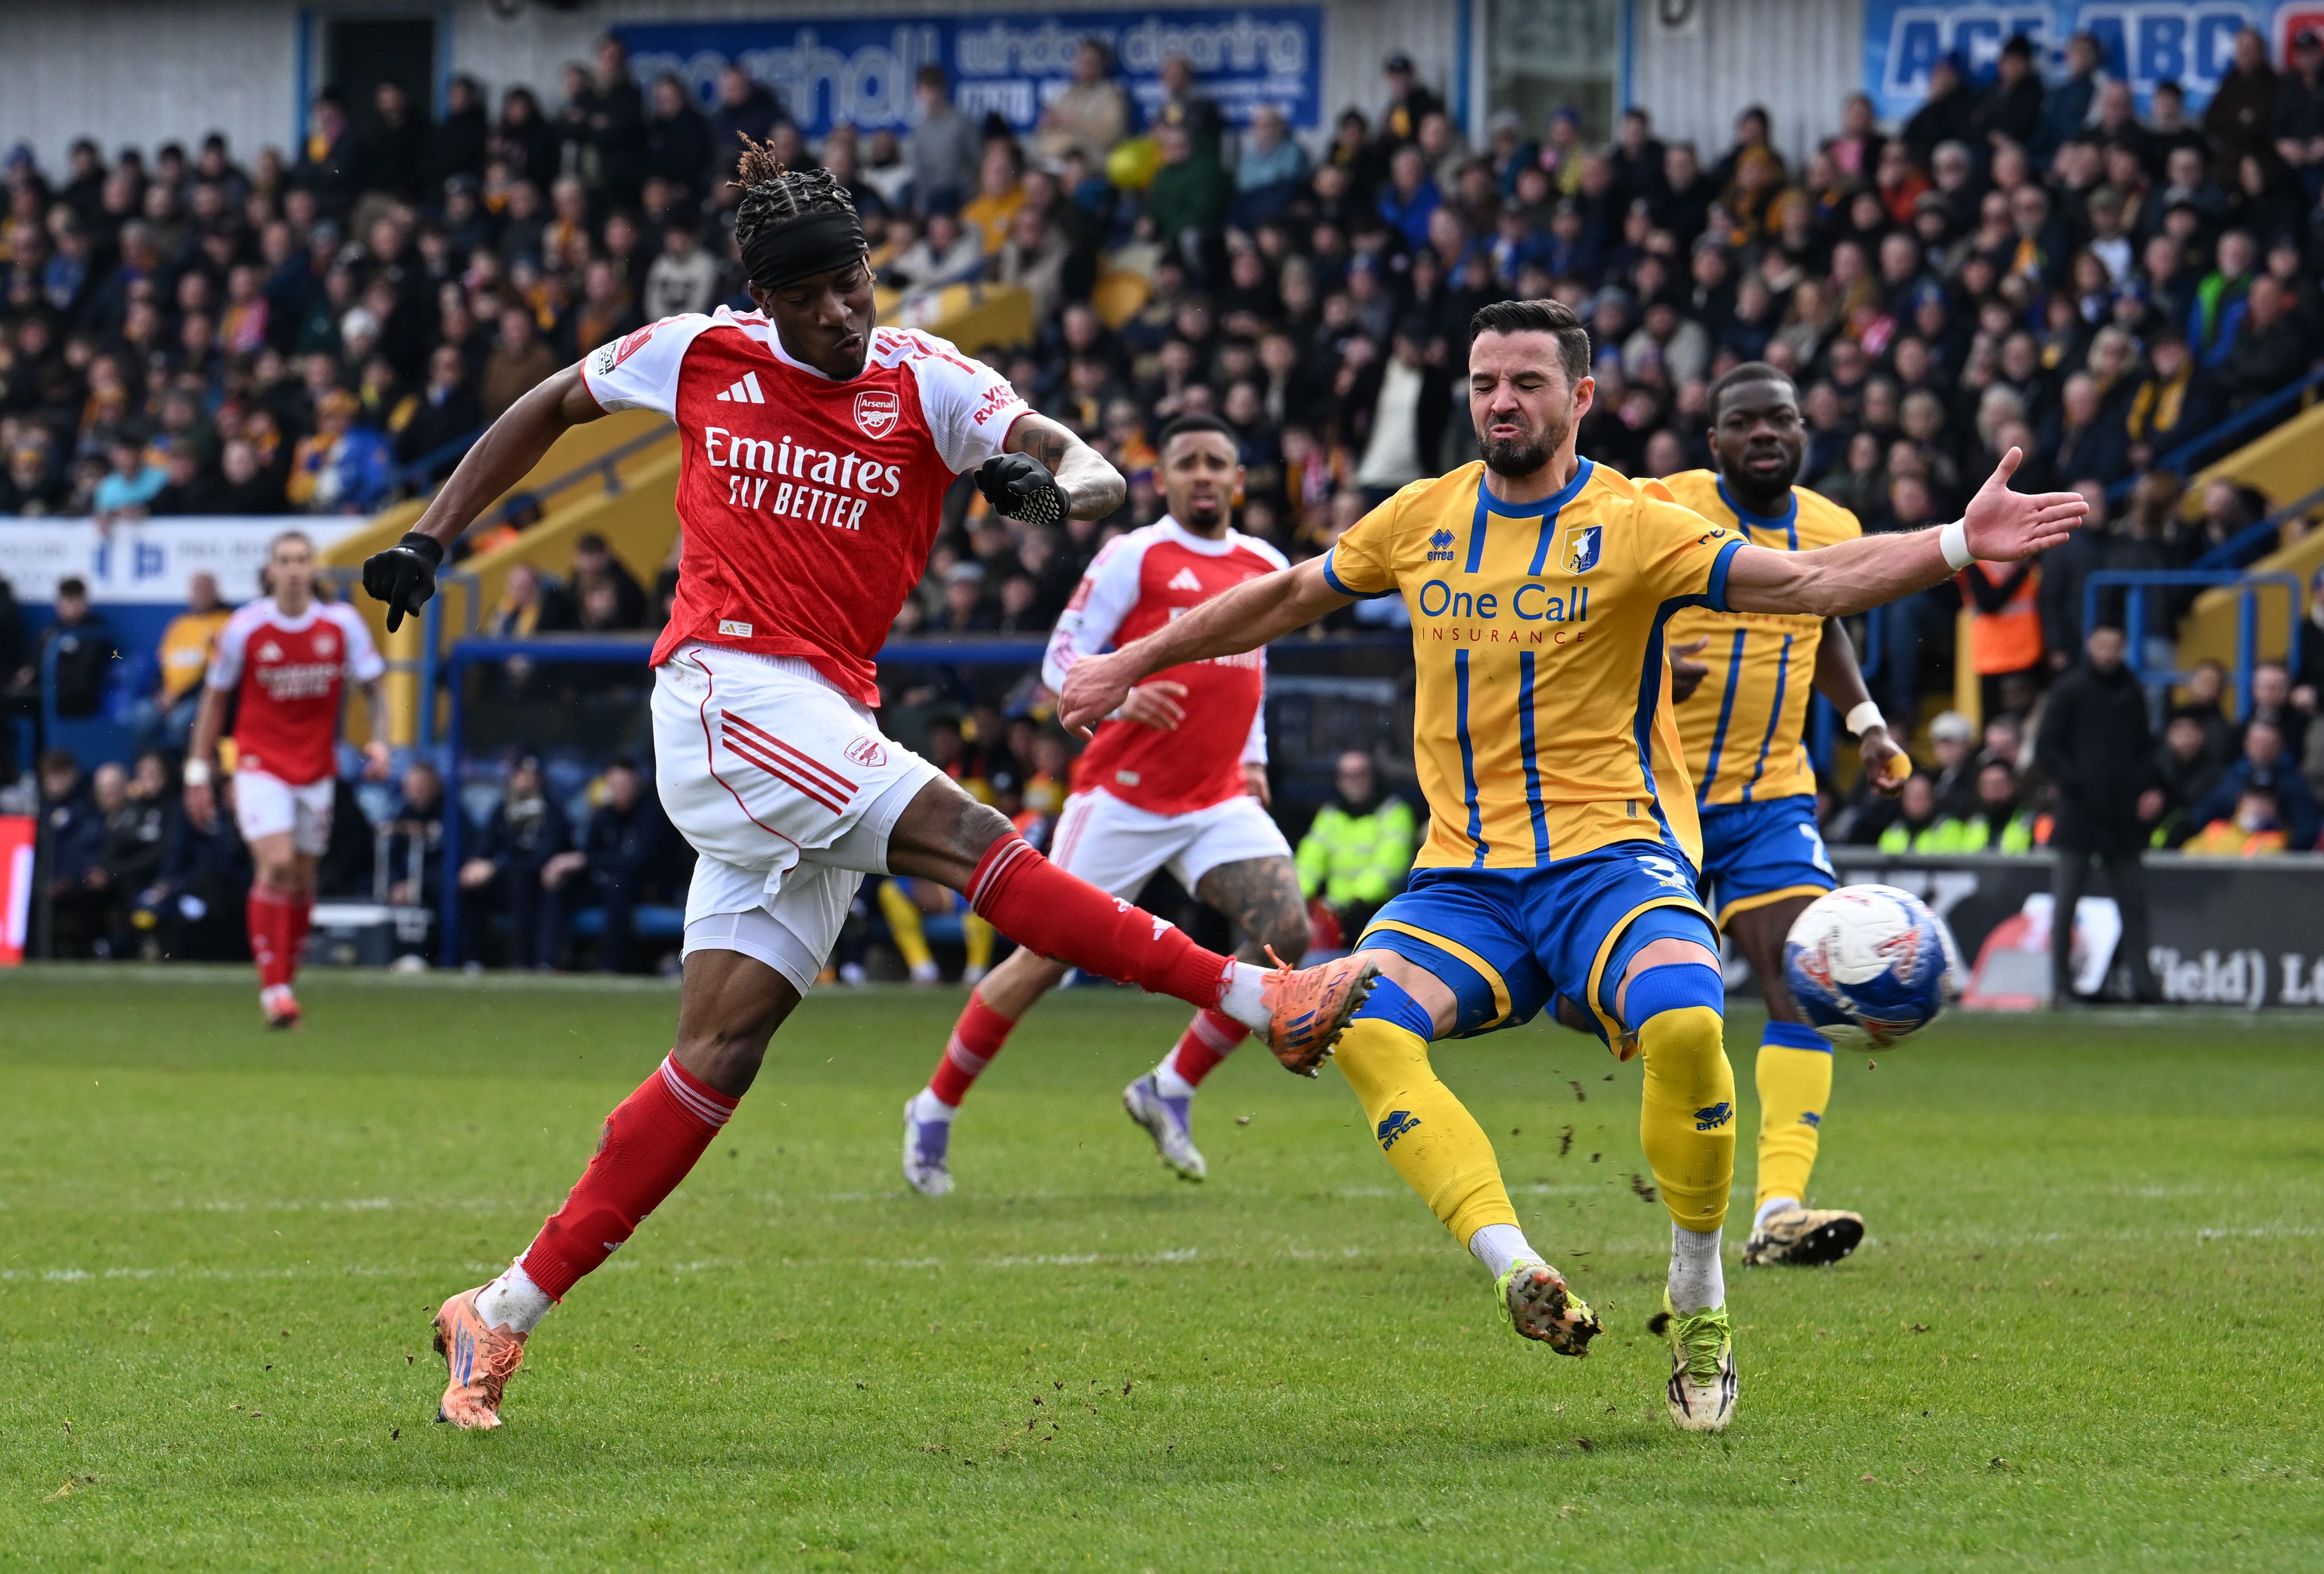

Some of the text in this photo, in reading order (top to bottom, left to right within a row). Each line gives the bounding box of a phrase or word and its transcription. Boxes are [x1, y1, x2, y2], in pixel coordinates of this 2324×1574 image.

[861, 399, 893, 408] Arsenal
[705, 427, 901, 497] Emirates
[729, 475, 868, 531] FLY BETTER
[1419, 579, 1589, 622] One Call
[1422, 627, 1587, 644] INSURANCE
[1636, 855, 1686, 886] 3
